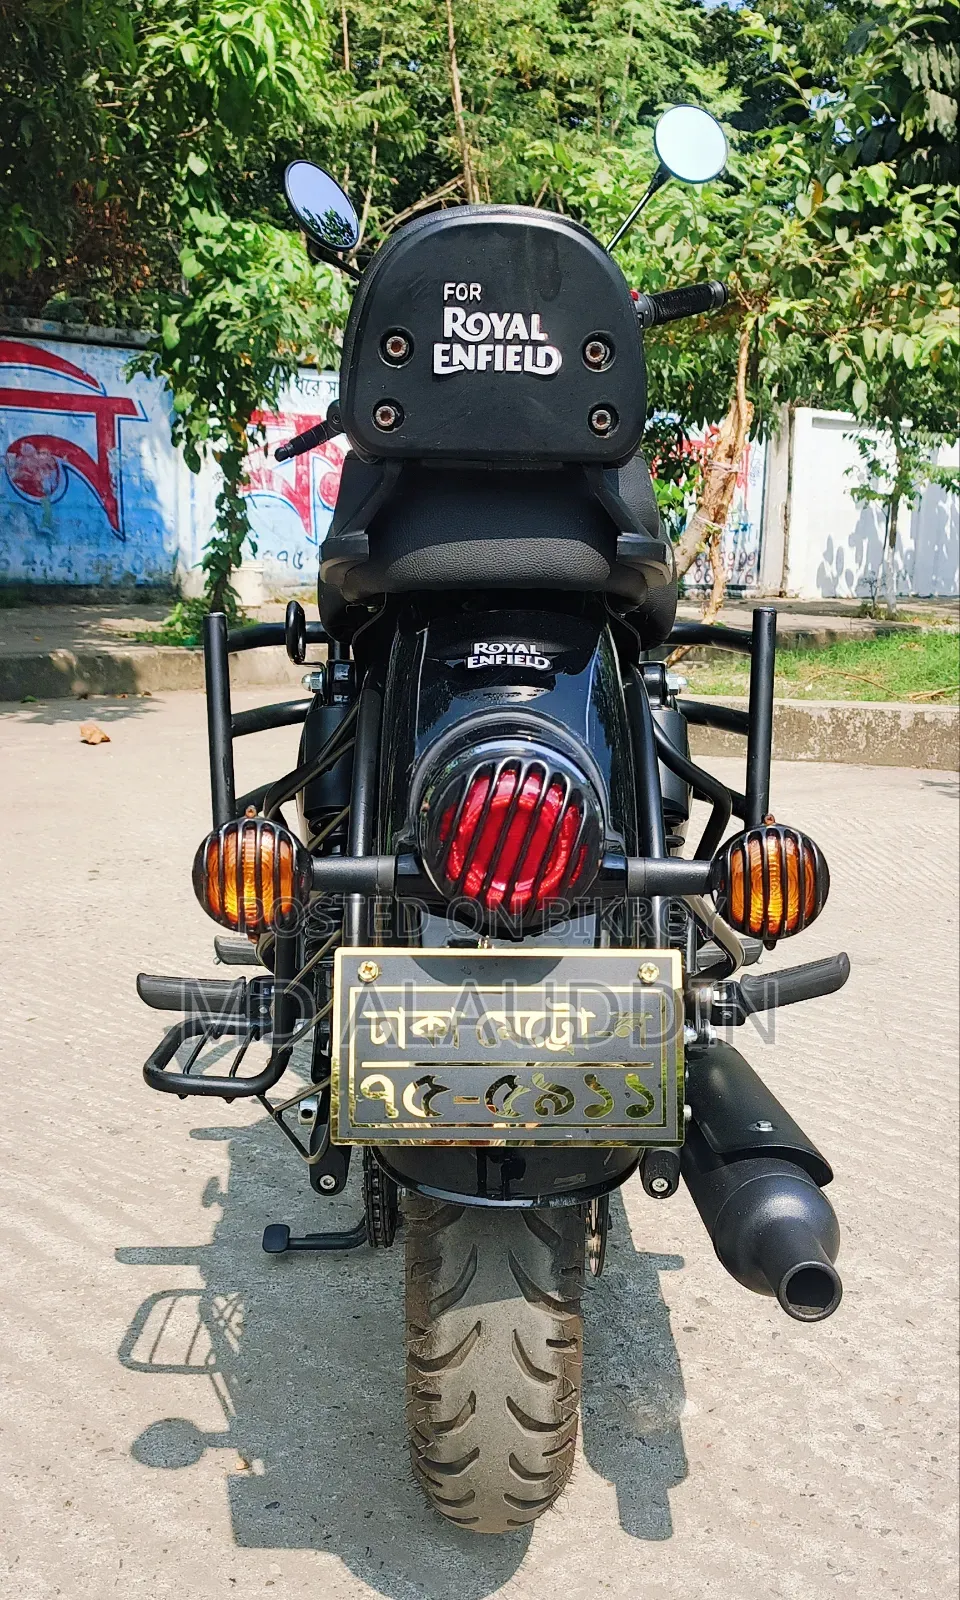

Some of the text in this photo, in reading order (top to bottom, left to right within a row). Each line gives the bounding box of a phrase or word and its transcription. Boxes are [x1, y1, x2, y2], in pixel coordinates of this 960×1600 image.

[443, 282, 482, 301] FOR
[443, 306, 548, 342] ROYAL
[433, 343, 563, 375] ENFIELD
[473, 642, 541, 655] ROYAL
[467, 654, 551, 670] ENFIELD
[363, 1007, 465, 1050] ঢাকা
